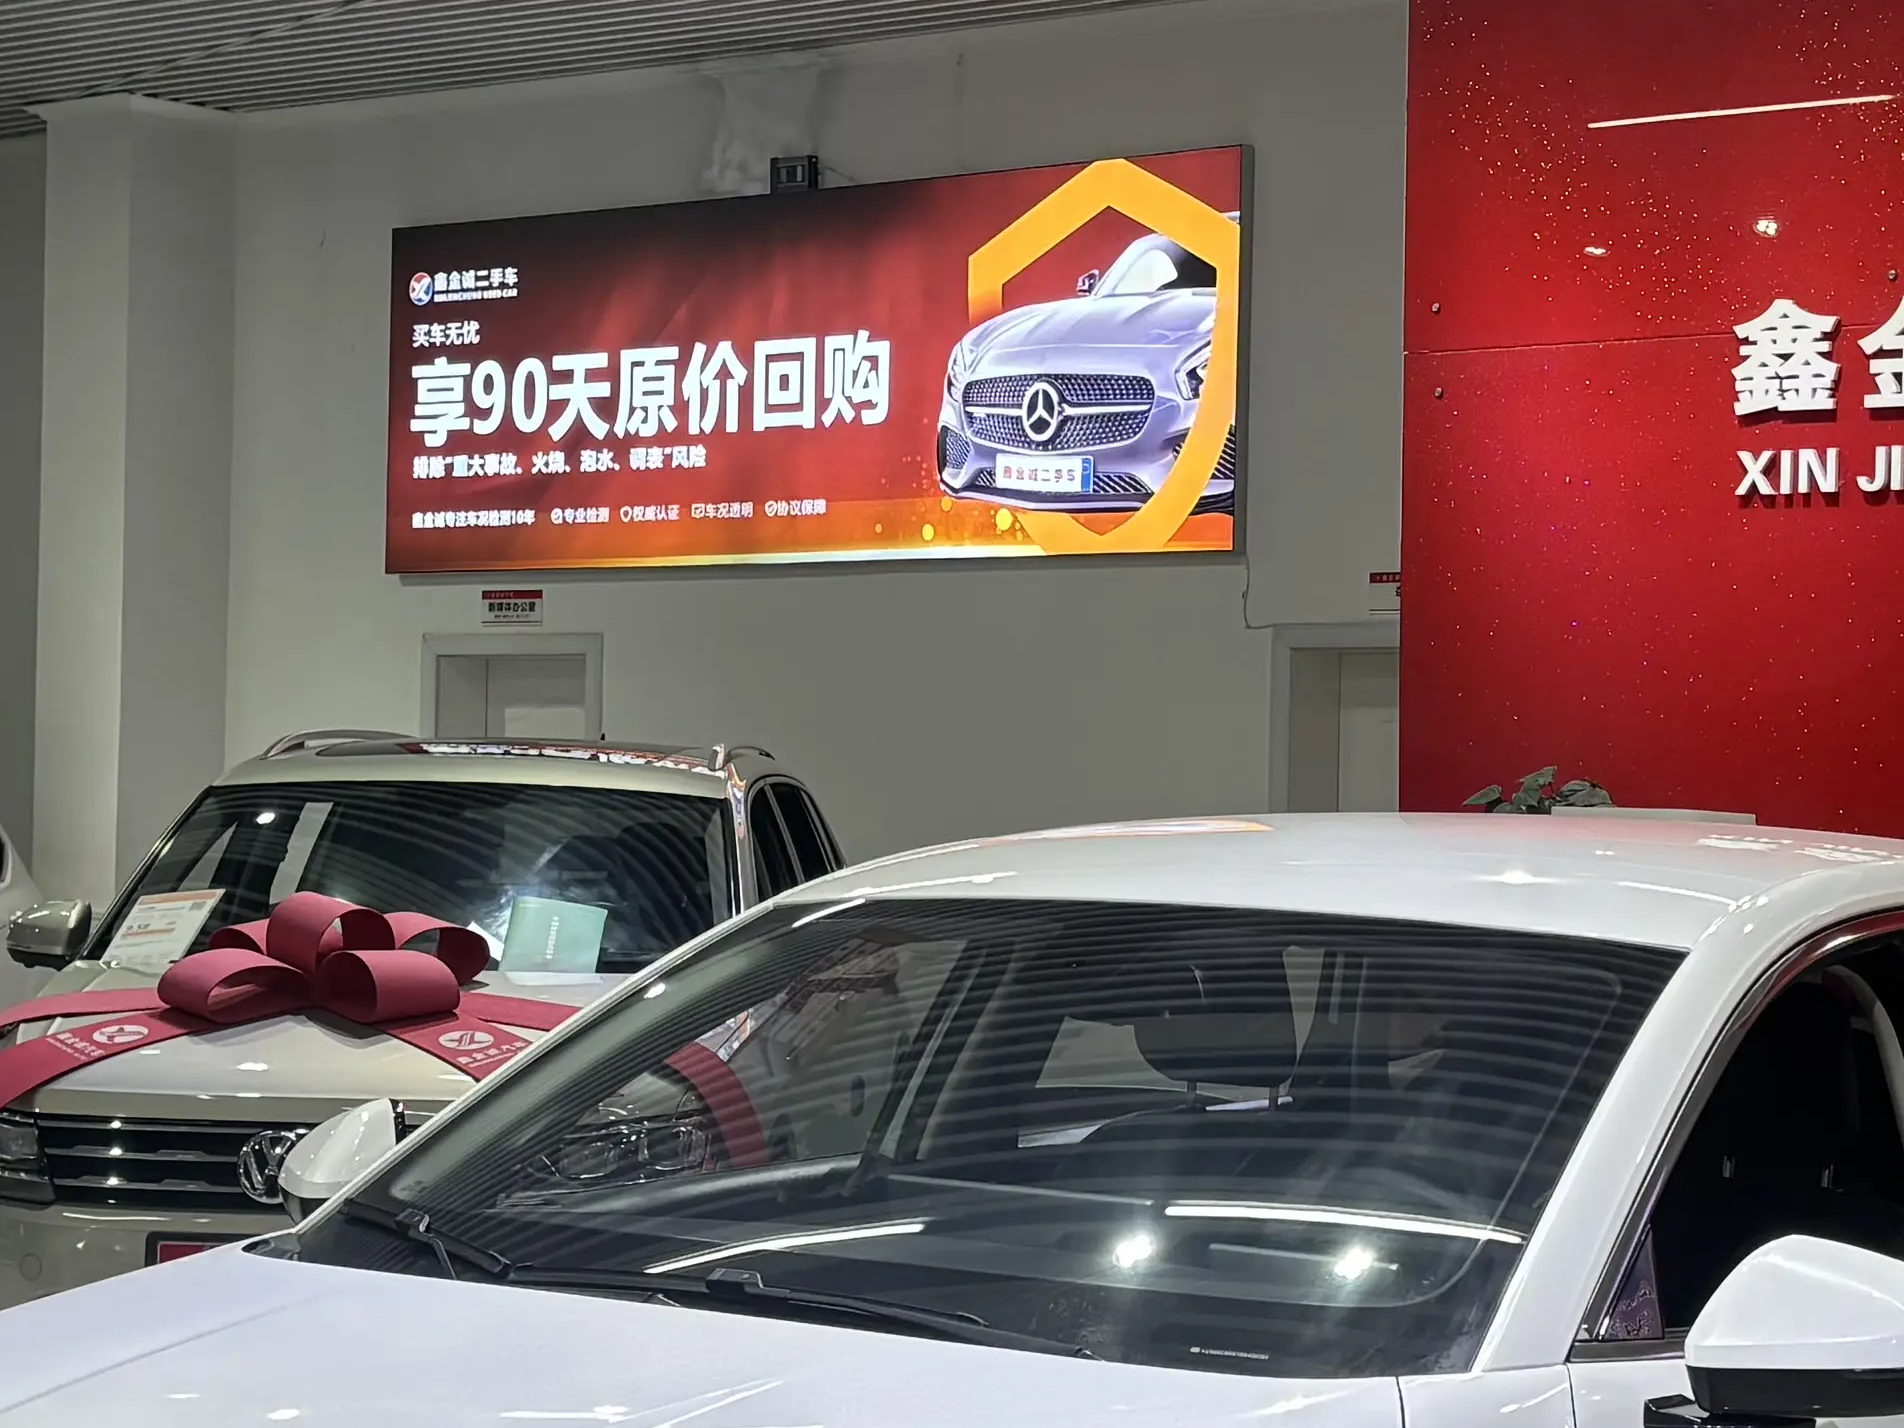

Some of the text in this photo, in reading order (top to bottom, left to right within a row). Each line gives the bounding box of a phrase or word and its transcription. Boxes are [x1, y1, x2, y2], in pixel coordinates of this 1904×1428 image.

[412, 320, 480, 347] 买车无忧
[410, 329, 891, 448] 享90天原价回购
[1734, 447, 1840, 496] XIN
